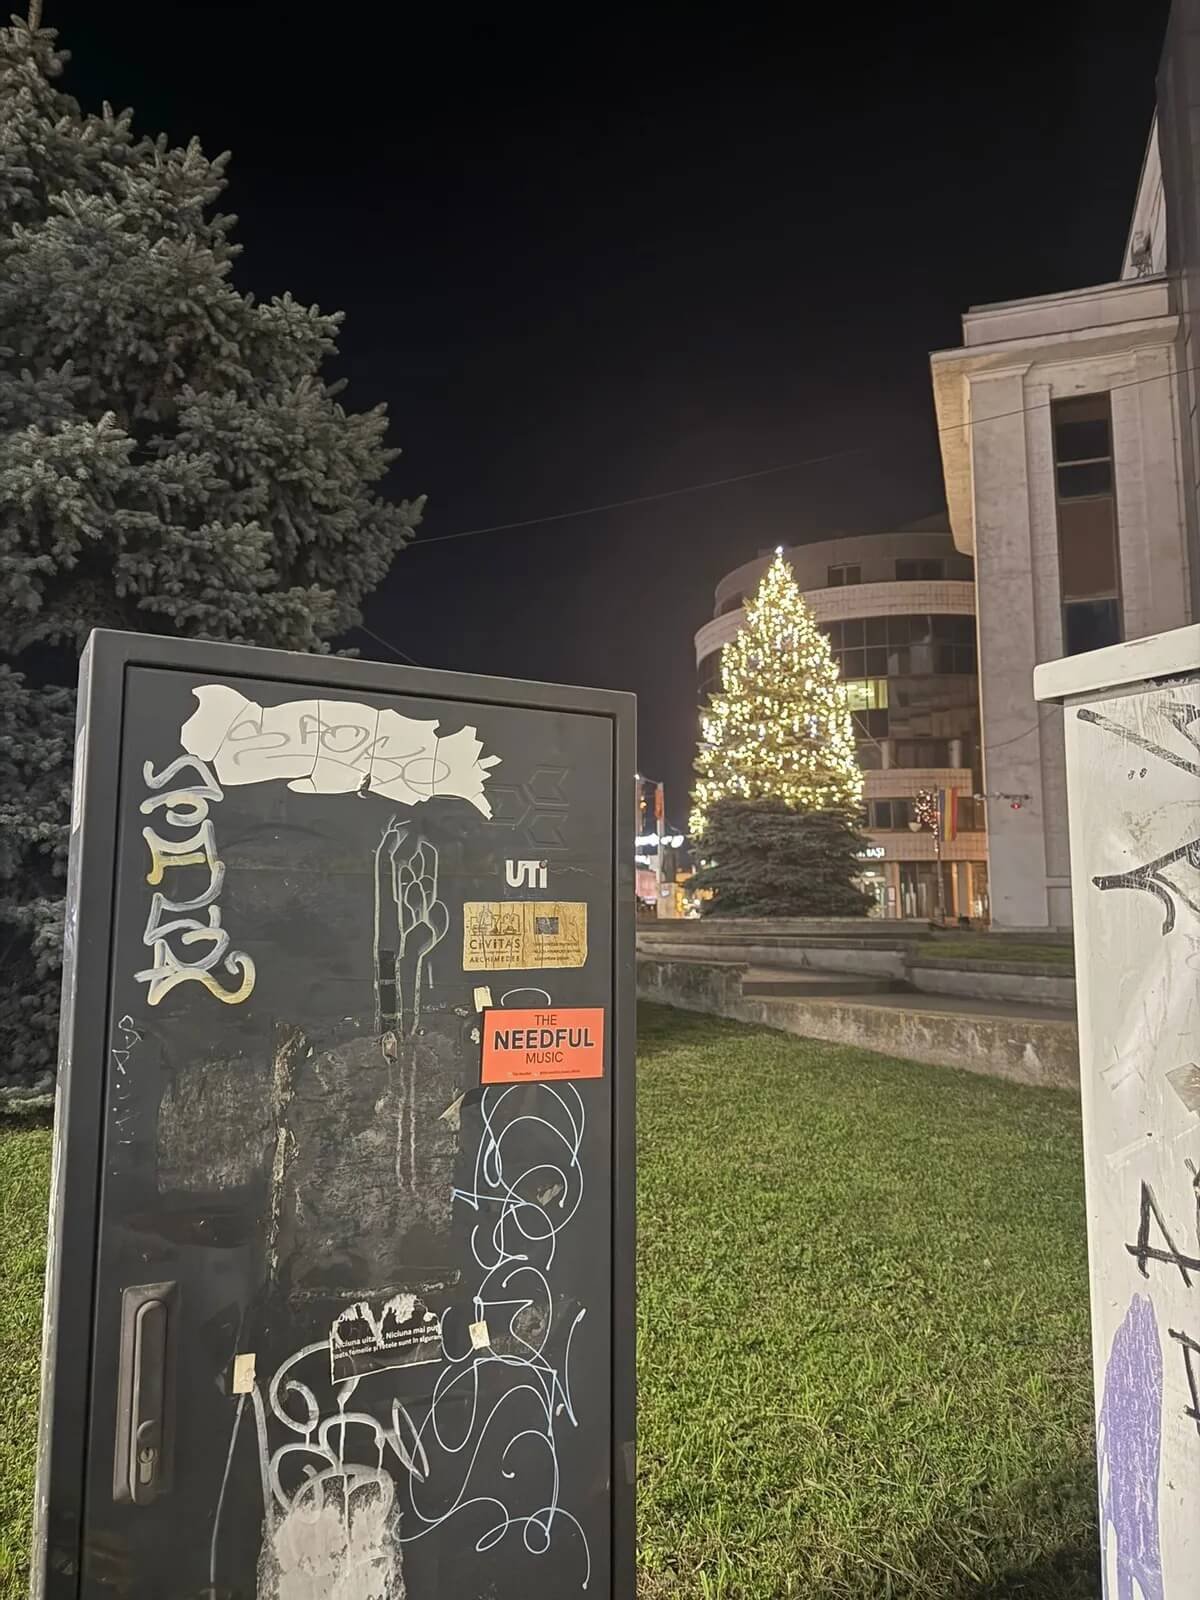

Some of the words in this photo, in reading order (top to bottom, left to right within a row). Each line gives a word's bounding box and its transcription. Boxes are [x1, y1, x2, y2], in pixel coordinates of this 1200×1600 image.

[534, 1014, 558, 1026] THE
[494, 1028, 594, 1050] NEEDFUL
[525, 1051, 564, 1065] MUSIC
[386, 1329, 412, 1339] Niciuna
[413, 1325, 426, 1334] mai
